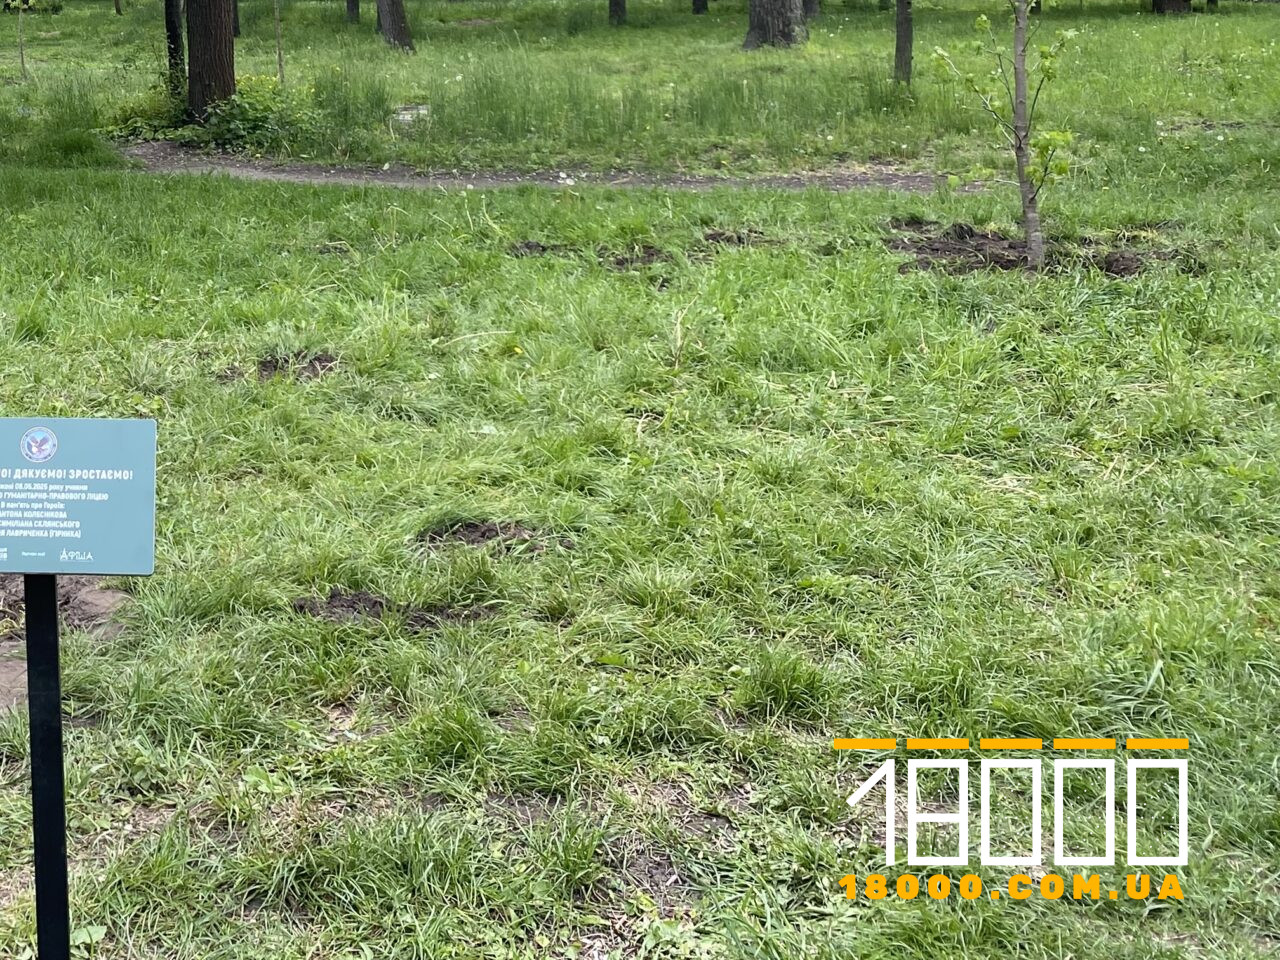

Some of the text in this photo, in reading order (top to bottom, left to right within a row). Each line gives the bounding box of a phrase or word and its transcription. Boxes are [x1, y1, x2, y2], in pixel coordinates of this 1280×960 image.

[13, 468, 66, 480] ДЯКУЄМО!
[69, 469, 133, 480] ЗРОСТАЄМО!
[48, 484, 64, 492] року
[4, 491, 85, 500] ГУМАНІТАРНО-ПРАВОВОГО
[86, 493, 109, 501] ЛІЦЕЮ
[31, 502, 43, 510] про
